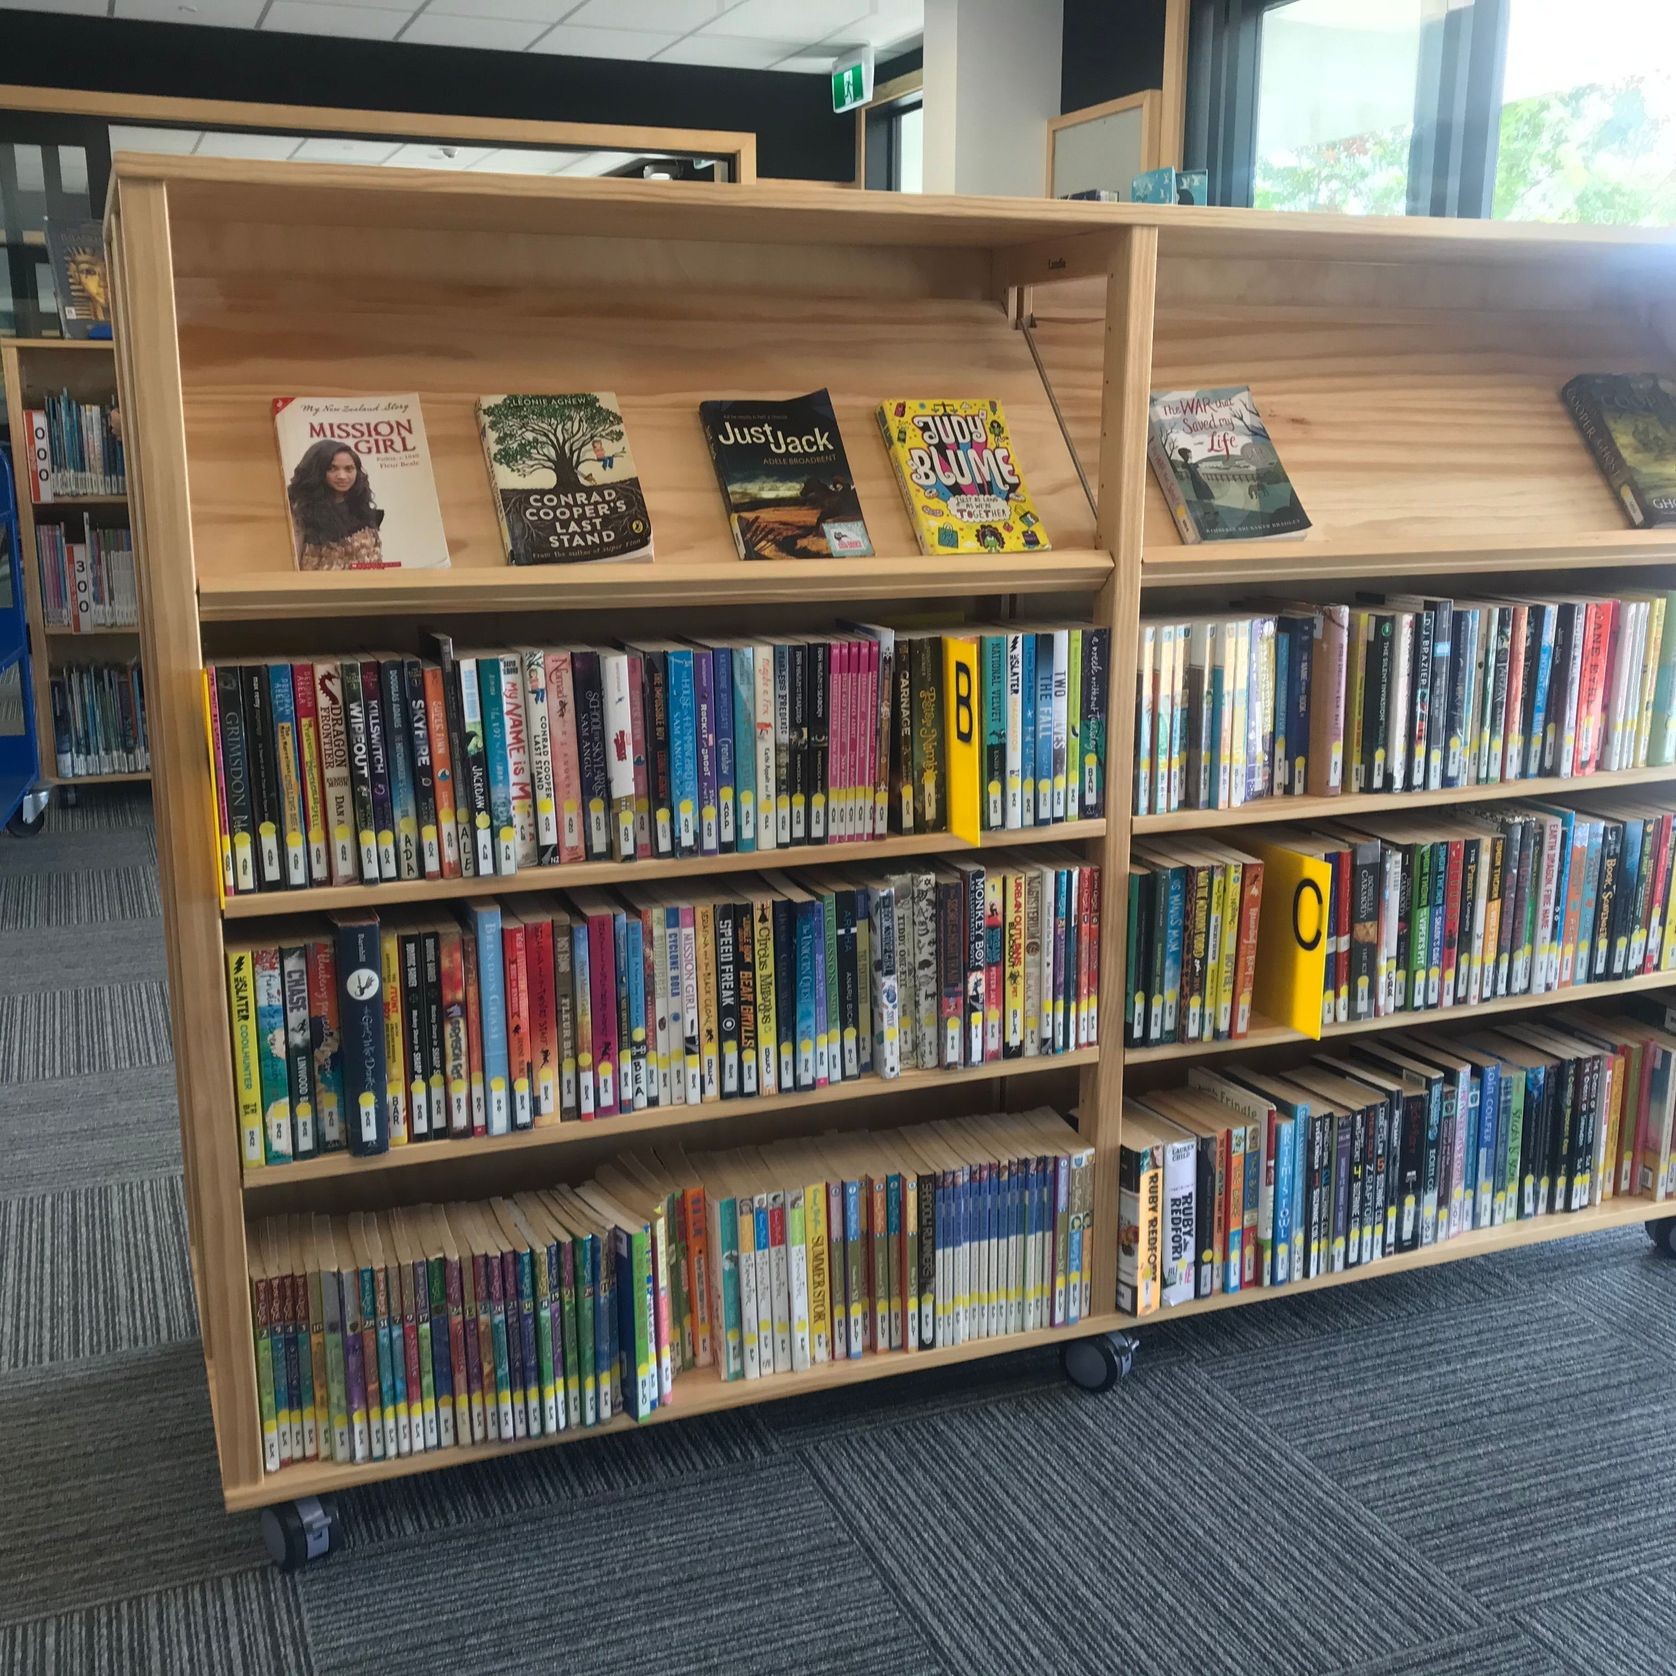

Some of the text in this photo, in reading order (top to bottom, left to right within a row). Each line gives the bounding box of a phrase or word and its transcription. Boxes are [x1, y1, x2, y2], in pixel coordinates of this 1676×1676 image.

[382, 402, 409, 414] Story
[512, 397, 587, 408] LEONIE AGNEW
[1180, 397, 1215, 416] WAR
[309, 418, 413, 440] MISSION
[354, 436, 417, 455] GIRL
[718, 420, 834, 455] Just Jack
[912, 413, 988, 445] JUDY
[1182, 415, 1235, 434] Saved my
[1207, 431, 1238, 461] Life
[763, 454, 837, 466] ADELE BROADBENT
[909, 445, 1020, 491] BLUME
[525, 500, 627, 521] COOPER'S
[529, 488, 617, 507] CONRAD
[956, 508, 1008, 520] TOGETHER
[549, 530, 616, 549] STAND
[555, 518, 603, 534] LAST
[548, 657, 569, 700] Nomad
[990, 642, 1002, 723] NATIONAL VELVET
[1009, 659, 1019, 695] SLATER
[1054, 669, 1066, 698] TWO
[1379, 641, 1390, 721] THE SILENT INVASION
[1419, 640, 1430, 686] BRAZIER
[389, 669, 402, 729] DOUGLAS ADAMS
[584, 690, 601, 734] SCHOOL
[777, 694, 788, 735] FREDERIC
[900, 671, 911, 737] CARNAGE
[956, 660, 974, 744] B
[1038, 674, 1052, 740] THE FALL
[1083, 645, 1103, 753] week without Tuesday
[319, 705, 336, 770] FRONTIER
[330, 704, 348, 769] DRAGON
[348, 701, 369, 778] WIPEOUT
[367, 699, 385, 774] KILLSWITCH
[410, 699, 431, 767] SKYFIRE
[432, 700, 446, 754] SUPER FINN
[504, 702, 528, 777] NAME is
[540, 715, 551, 756] CONRAD
[580, 713, 590, 737] SAM
[224, 711, 247, 807] GRIMSDON
[533, 734, 545, 787] LAST STAND
[581, 739, 593, 778] ANGUS
[673, 738, 683, 776] ANGUS
[717, 737, 732, 776] Crenshaw
[334, 795, 346, 817] DAN
[471, 764, 486, 809] JACKDAW
[969, 880, 975, 892] AN
[1358, 869, 1369, 919] CARMODY
[1466, 848, 1477, 902] THE PIRATE
[1540, 824, 1559, 930] EARTH FIRE HARE
[1604, 858, 1618, 887] BOOK
[1025, 875, 1041, 941] MAGISTERIUM
[1292, 878, 1323, 952] C
[1398, 872, 1407, 917] CARMODY
[897, 914, 907, 946] TEDDY
[974, 877, 985, 979] MONKEY BOY
[1013, 877, 1023, 977] URBAN OUTLAWS
[1416, 922, 1427, 965] VIPER'S PIT
[1432, 916, 1442, 946] SHARK'S
[668, 932, 679, 971] CYCLONE
[683, 933, 696, 1013] MISSION GIRL
[719, 920, 735, 1006] SPEED FREAK
[825, 924, 837, 984] BESSON
[1007, 931, 1015, 979] BLACKOUT
[757, 927, 773, 1026] Circus Mirandus
[845, 972, 853, 1001] ANARU
[989, 976, 998, 1014] PETER JAY
[560, 998, 570, 1029] FLEUR
[739, 970, 755, 1048] BEAR GRYLLS
[235, 982, 253, 1090] SLATER COOLHUNTER
[286, 969, 309, 1094] CHASE LINWOOD
[412, 1051, 422, 1074] SHARP
[432, 1047, 441, 1069] SHARP
[634, 1060, 645, 1098] BEA
[392, 1096, 401, 1126] BAR
[1220, 1090, 1258, 1119] Frindle
[1483, 1098, 1494, 1142] COLFER
[1171, 1144, 1195, 1156] LAUREN
[1171, 1152, 1191, 1162] CHILD
[1313, 1188, 1321, 1221] SUZANNE
[1351, 1181, 1361, 1217] SUZANNE
[1374, 1174, 1384, 1209] SUZANNE
[1147, 1172, 1160, 1283] RUBY REDFORT
[1181, 1191, 1194, 1239] RUBY
[811, 1234, 826, 1291] SUMMER
[922, 1227, 933, 1277] RUNNERS
